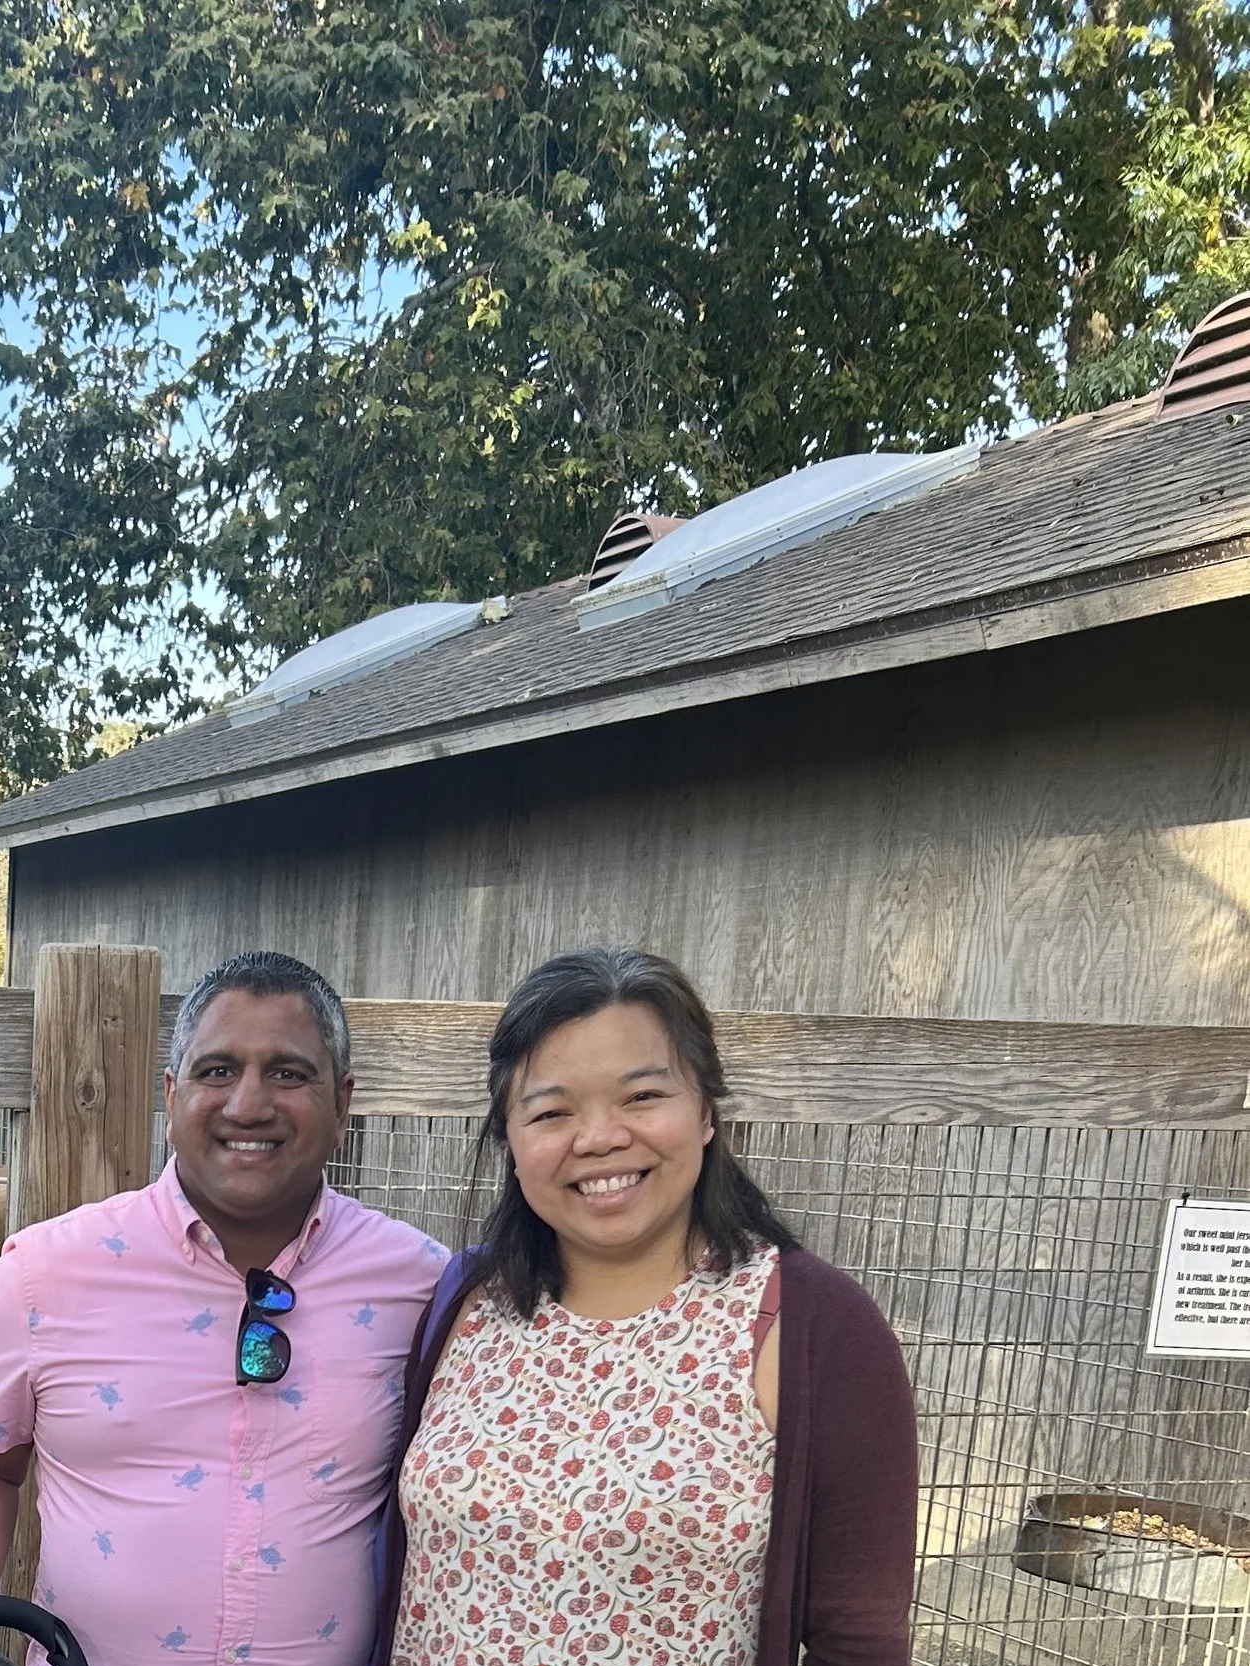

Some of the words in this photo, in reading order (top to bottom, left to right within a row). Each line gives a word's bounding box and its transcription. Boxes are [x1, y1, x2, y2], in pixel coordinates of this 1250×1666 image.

[1184, 1228, 1197, 1237] Our
[1181, 1242, 1201, 1251] which
[1202, 1243, 1208, 1252] is
[1210, 1244, 1225, 1252] well
[1226, 1245, 1241, 1254] past
[1231, 1259, 1243, 1267] her
[1176, 1272, 1184, 1280] As
[1216, 1274, 1227, 1282] she
[1229, 1274, 1235, 1283] is
[1178, 1286, 1185, 1294] of
[1219, 1288, 1230, 1296] She
[1231, 1288, 1238, 1297] is
[1229, 1302, 1241, 1310] The
[1207, 1315, 1219, 1323] but
[1220, 1316, 1238, 1324] there
